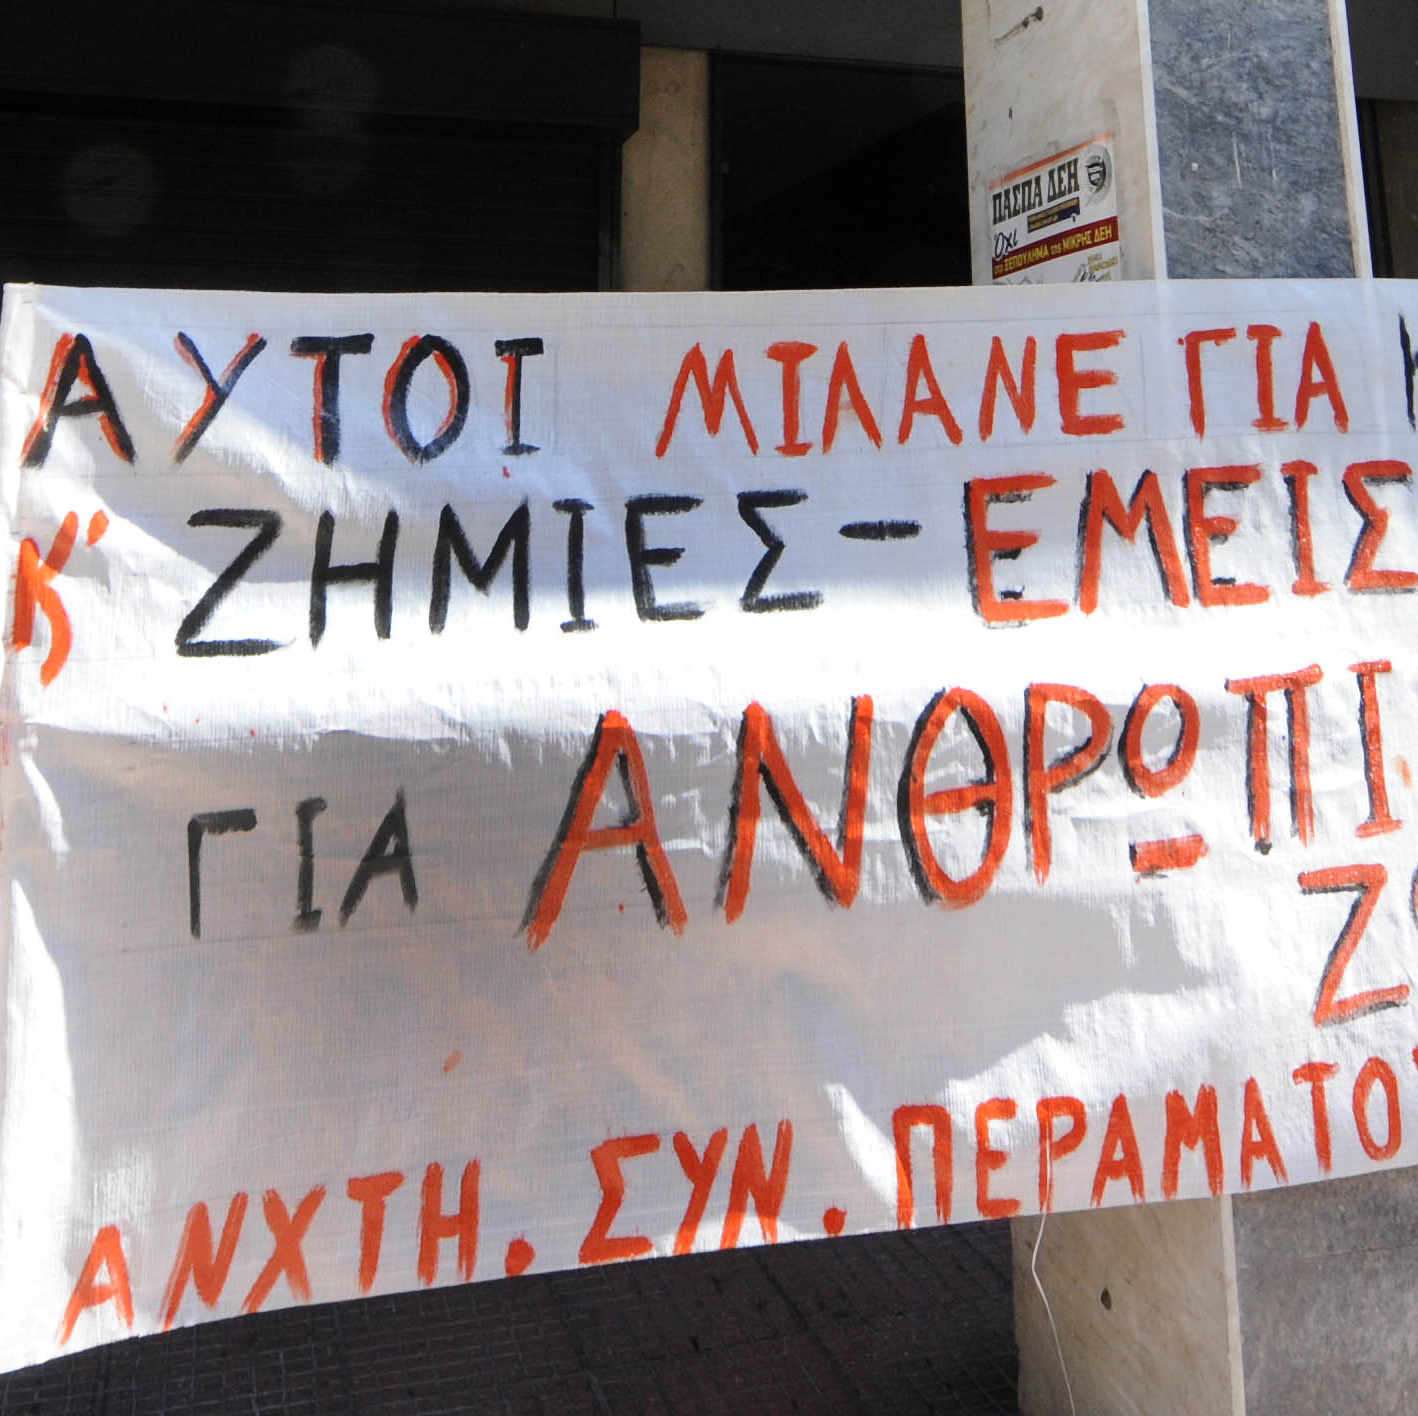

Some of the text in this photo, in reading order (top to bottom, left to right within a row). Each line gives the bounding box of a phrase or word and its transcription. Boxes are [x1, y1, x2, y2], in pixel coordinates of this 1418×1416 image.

[992, 175, 1043, 225] ΠΑΣΠΑ
[1047, 157, 1080, 203] ΔΕΗ
[1093, 224, 1113, 243] ΔΕΗ
[21, 332, 544, 468] ΑΥΤΟΙ
[656, 328, 1127, 457] ΜΙΛΑΝΕ
[1179, 321, 1348, 439] ΓΙΑ
[187, 786, 419, 940] ΓΙΑ
